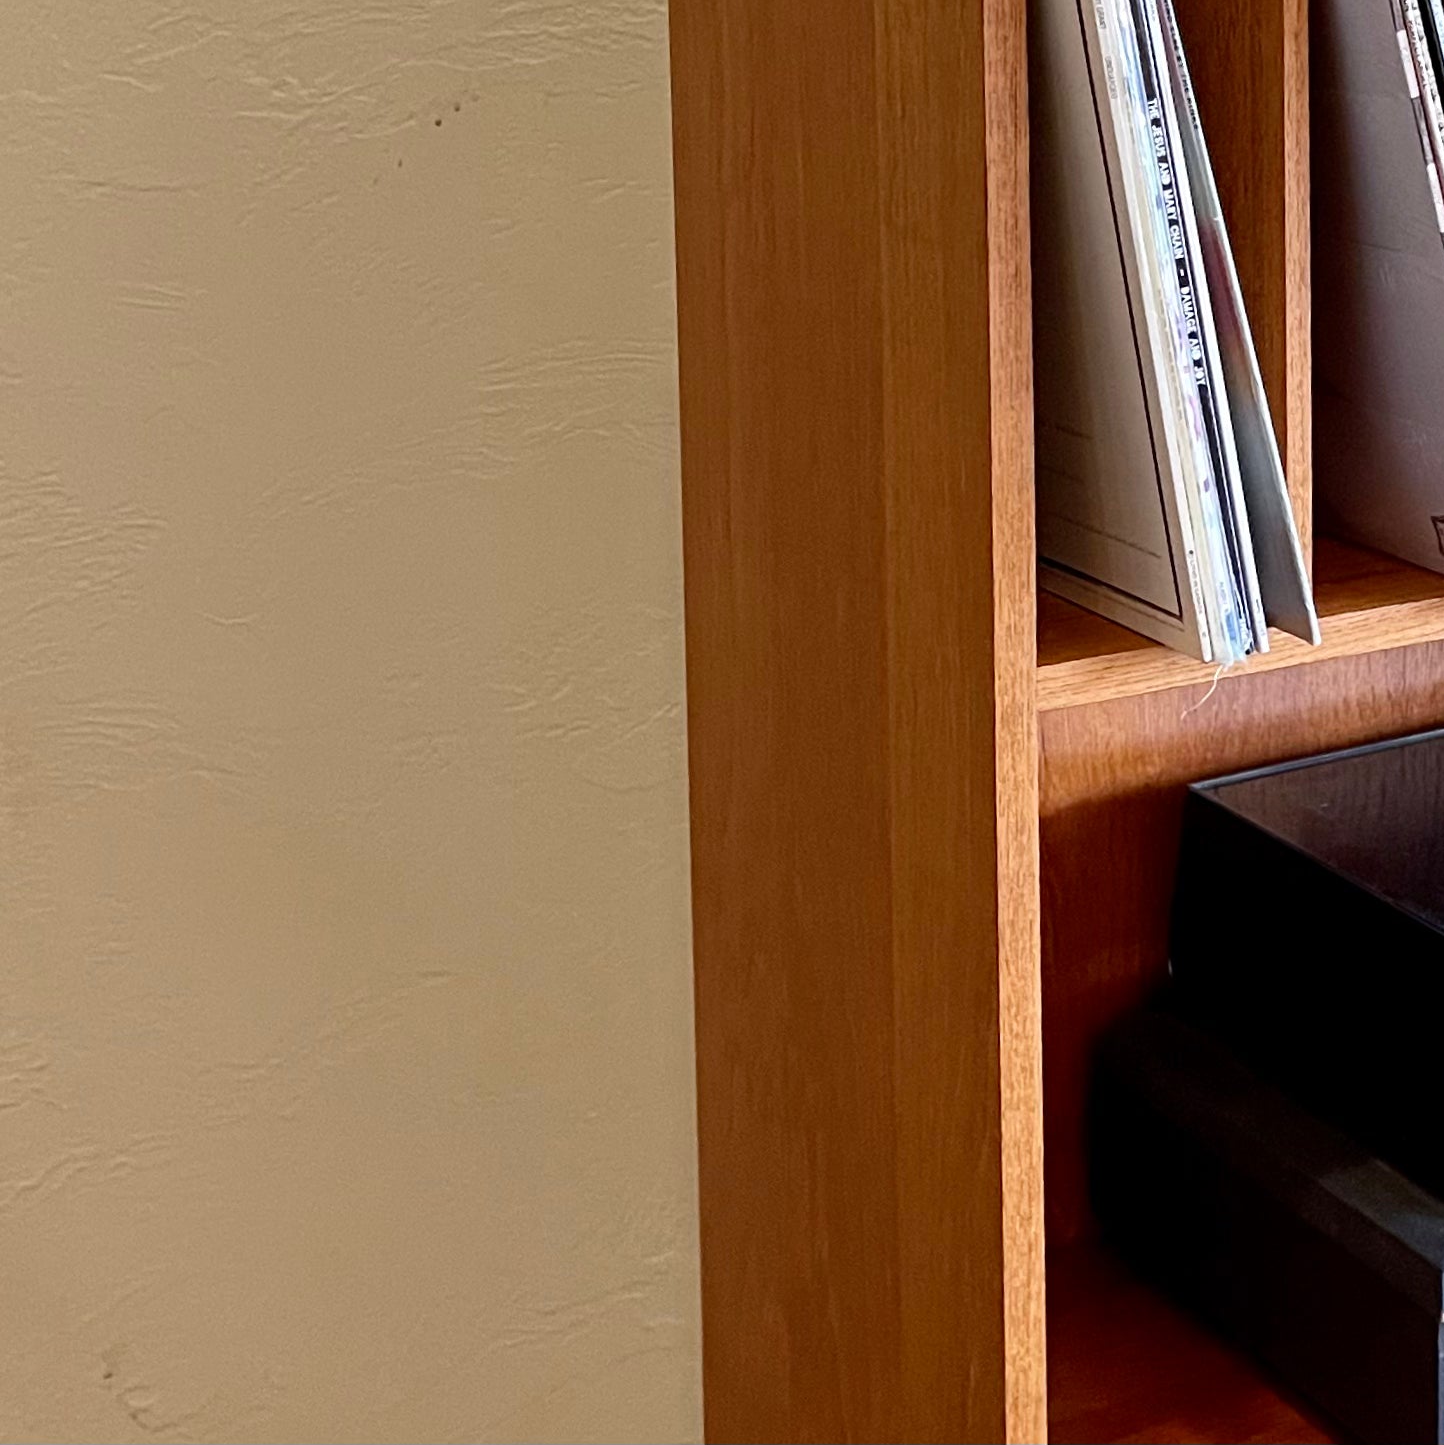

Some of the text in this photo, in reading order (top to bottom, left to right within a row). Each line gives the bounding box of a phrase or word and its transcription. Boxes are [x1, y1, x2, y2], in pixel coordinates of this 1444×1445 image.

[1147, 97, 1160, 119] THE
[1151, 124, 1167, 157] JESUS
[1158, 162, 1172, 185] AND
[1163, 189, 1178, 220] MARY
[1169, 225, 1185, 259] CHAIN
[1180, 286, 1199, 335] DAMAGE
[1188, 337, 1202, 361] AND
[1194, 365, 1207, 386] JOY
